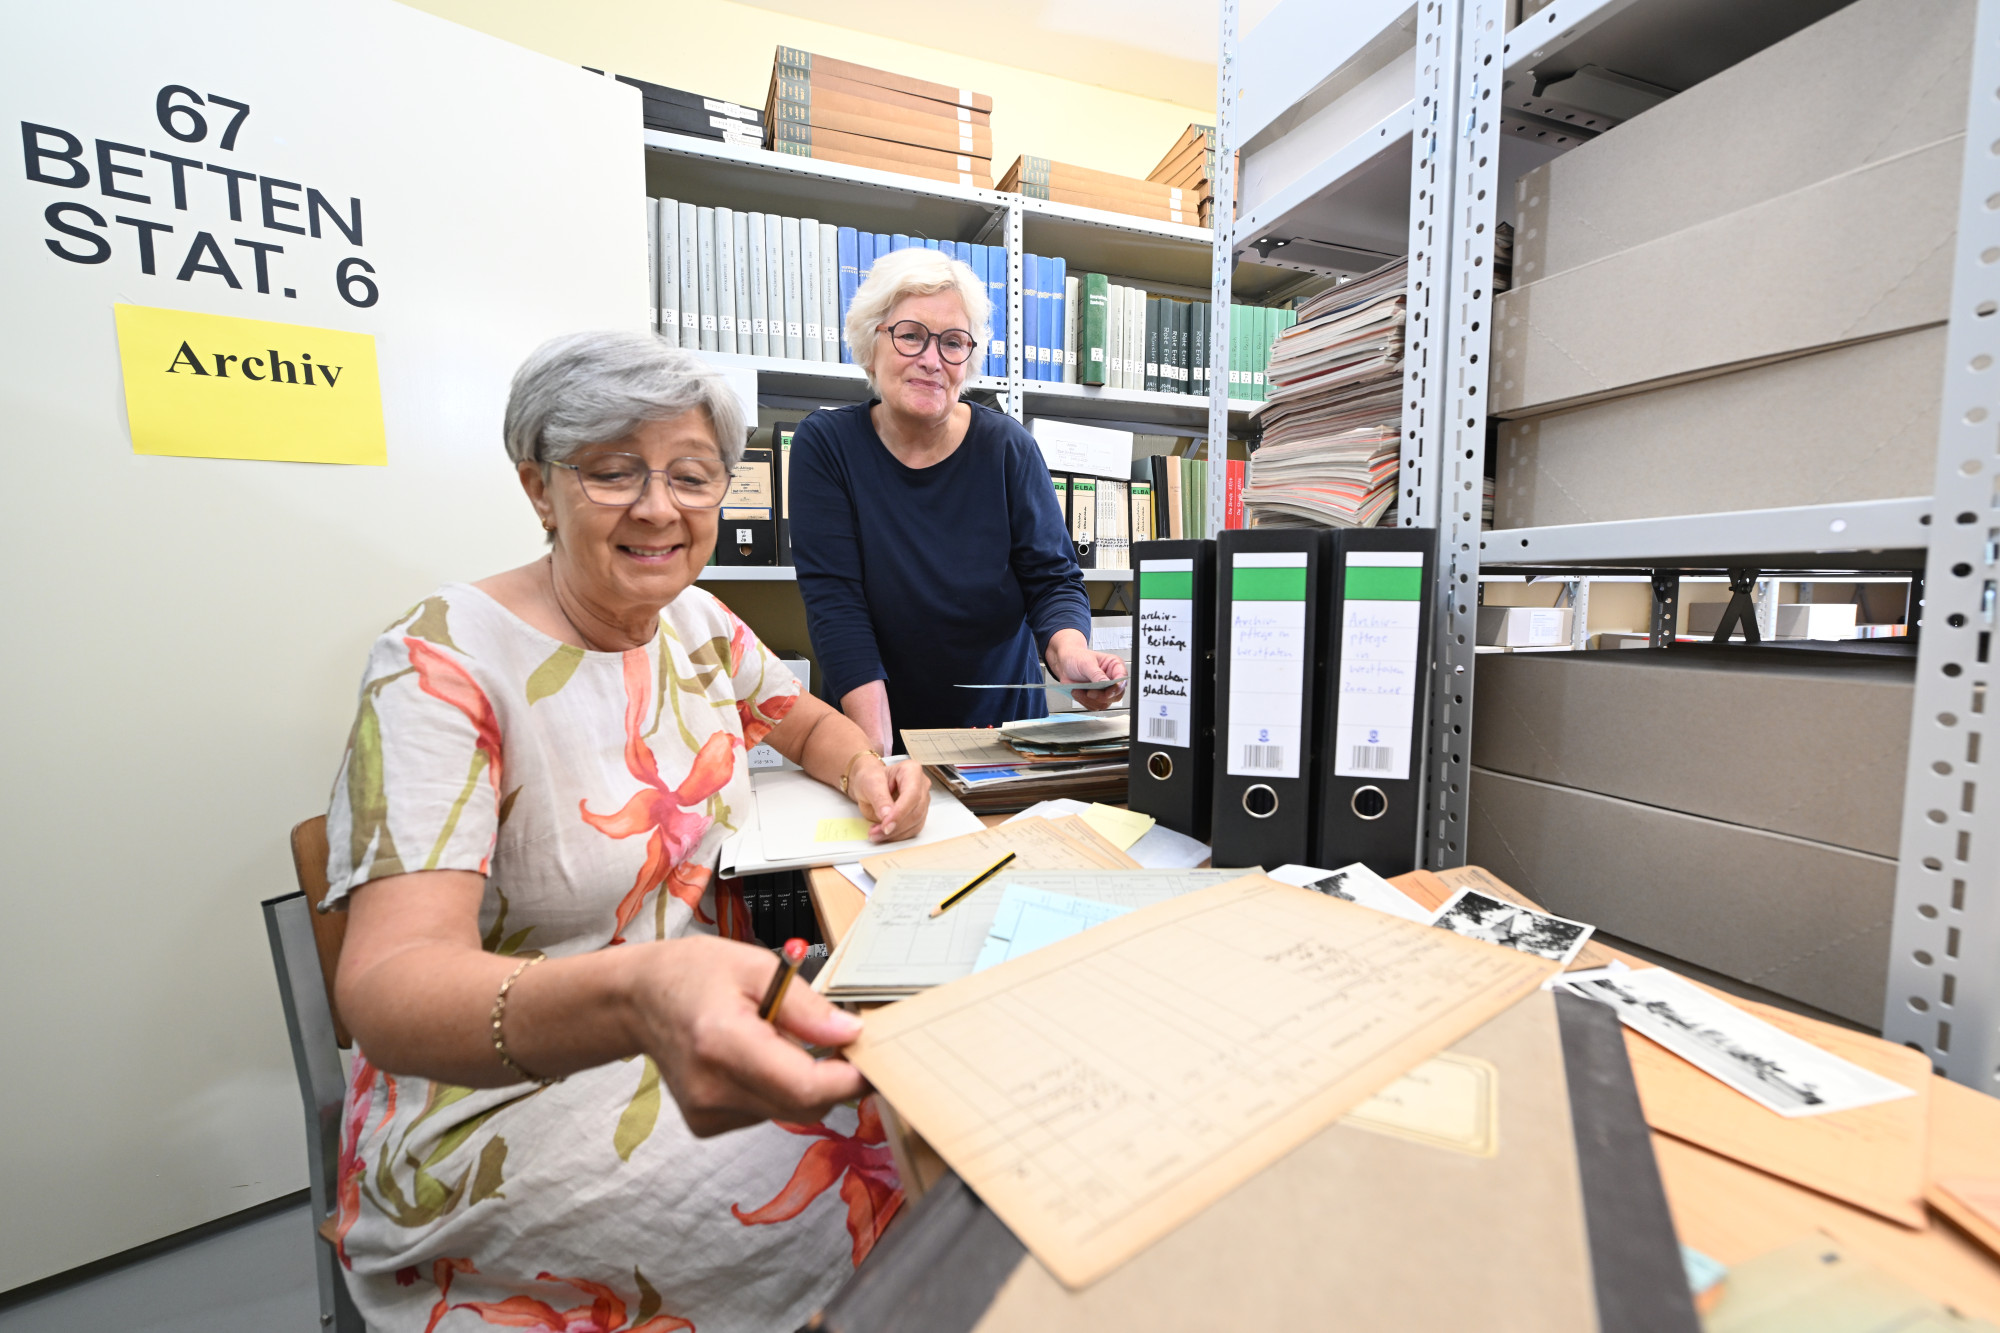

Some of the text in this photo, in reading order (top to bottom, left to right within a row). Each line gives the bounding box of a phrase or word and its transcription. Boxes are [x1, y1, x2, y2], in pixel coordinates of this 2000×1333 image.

[156, 84, 250, 152] 67
[21, 120, 363, 247] BETTEN
[44, 202, 379, 308] STAT. 6
[164, 340, 344, 388] Archiv
[1141, 611, 1176, 620] archiv-
[1234, 615, 1277, 627] Archiv-
[1348, 612, 1398, 628] Archiv-
[1240, 626, 1272, 642] pflege
[1350, 631, 1388, 648] pflege
[1148, 635, 1186, 652] Beiträge
[1145, 654, 1165, 666] STA
[1143, 684, 1187, 697] gladbach
